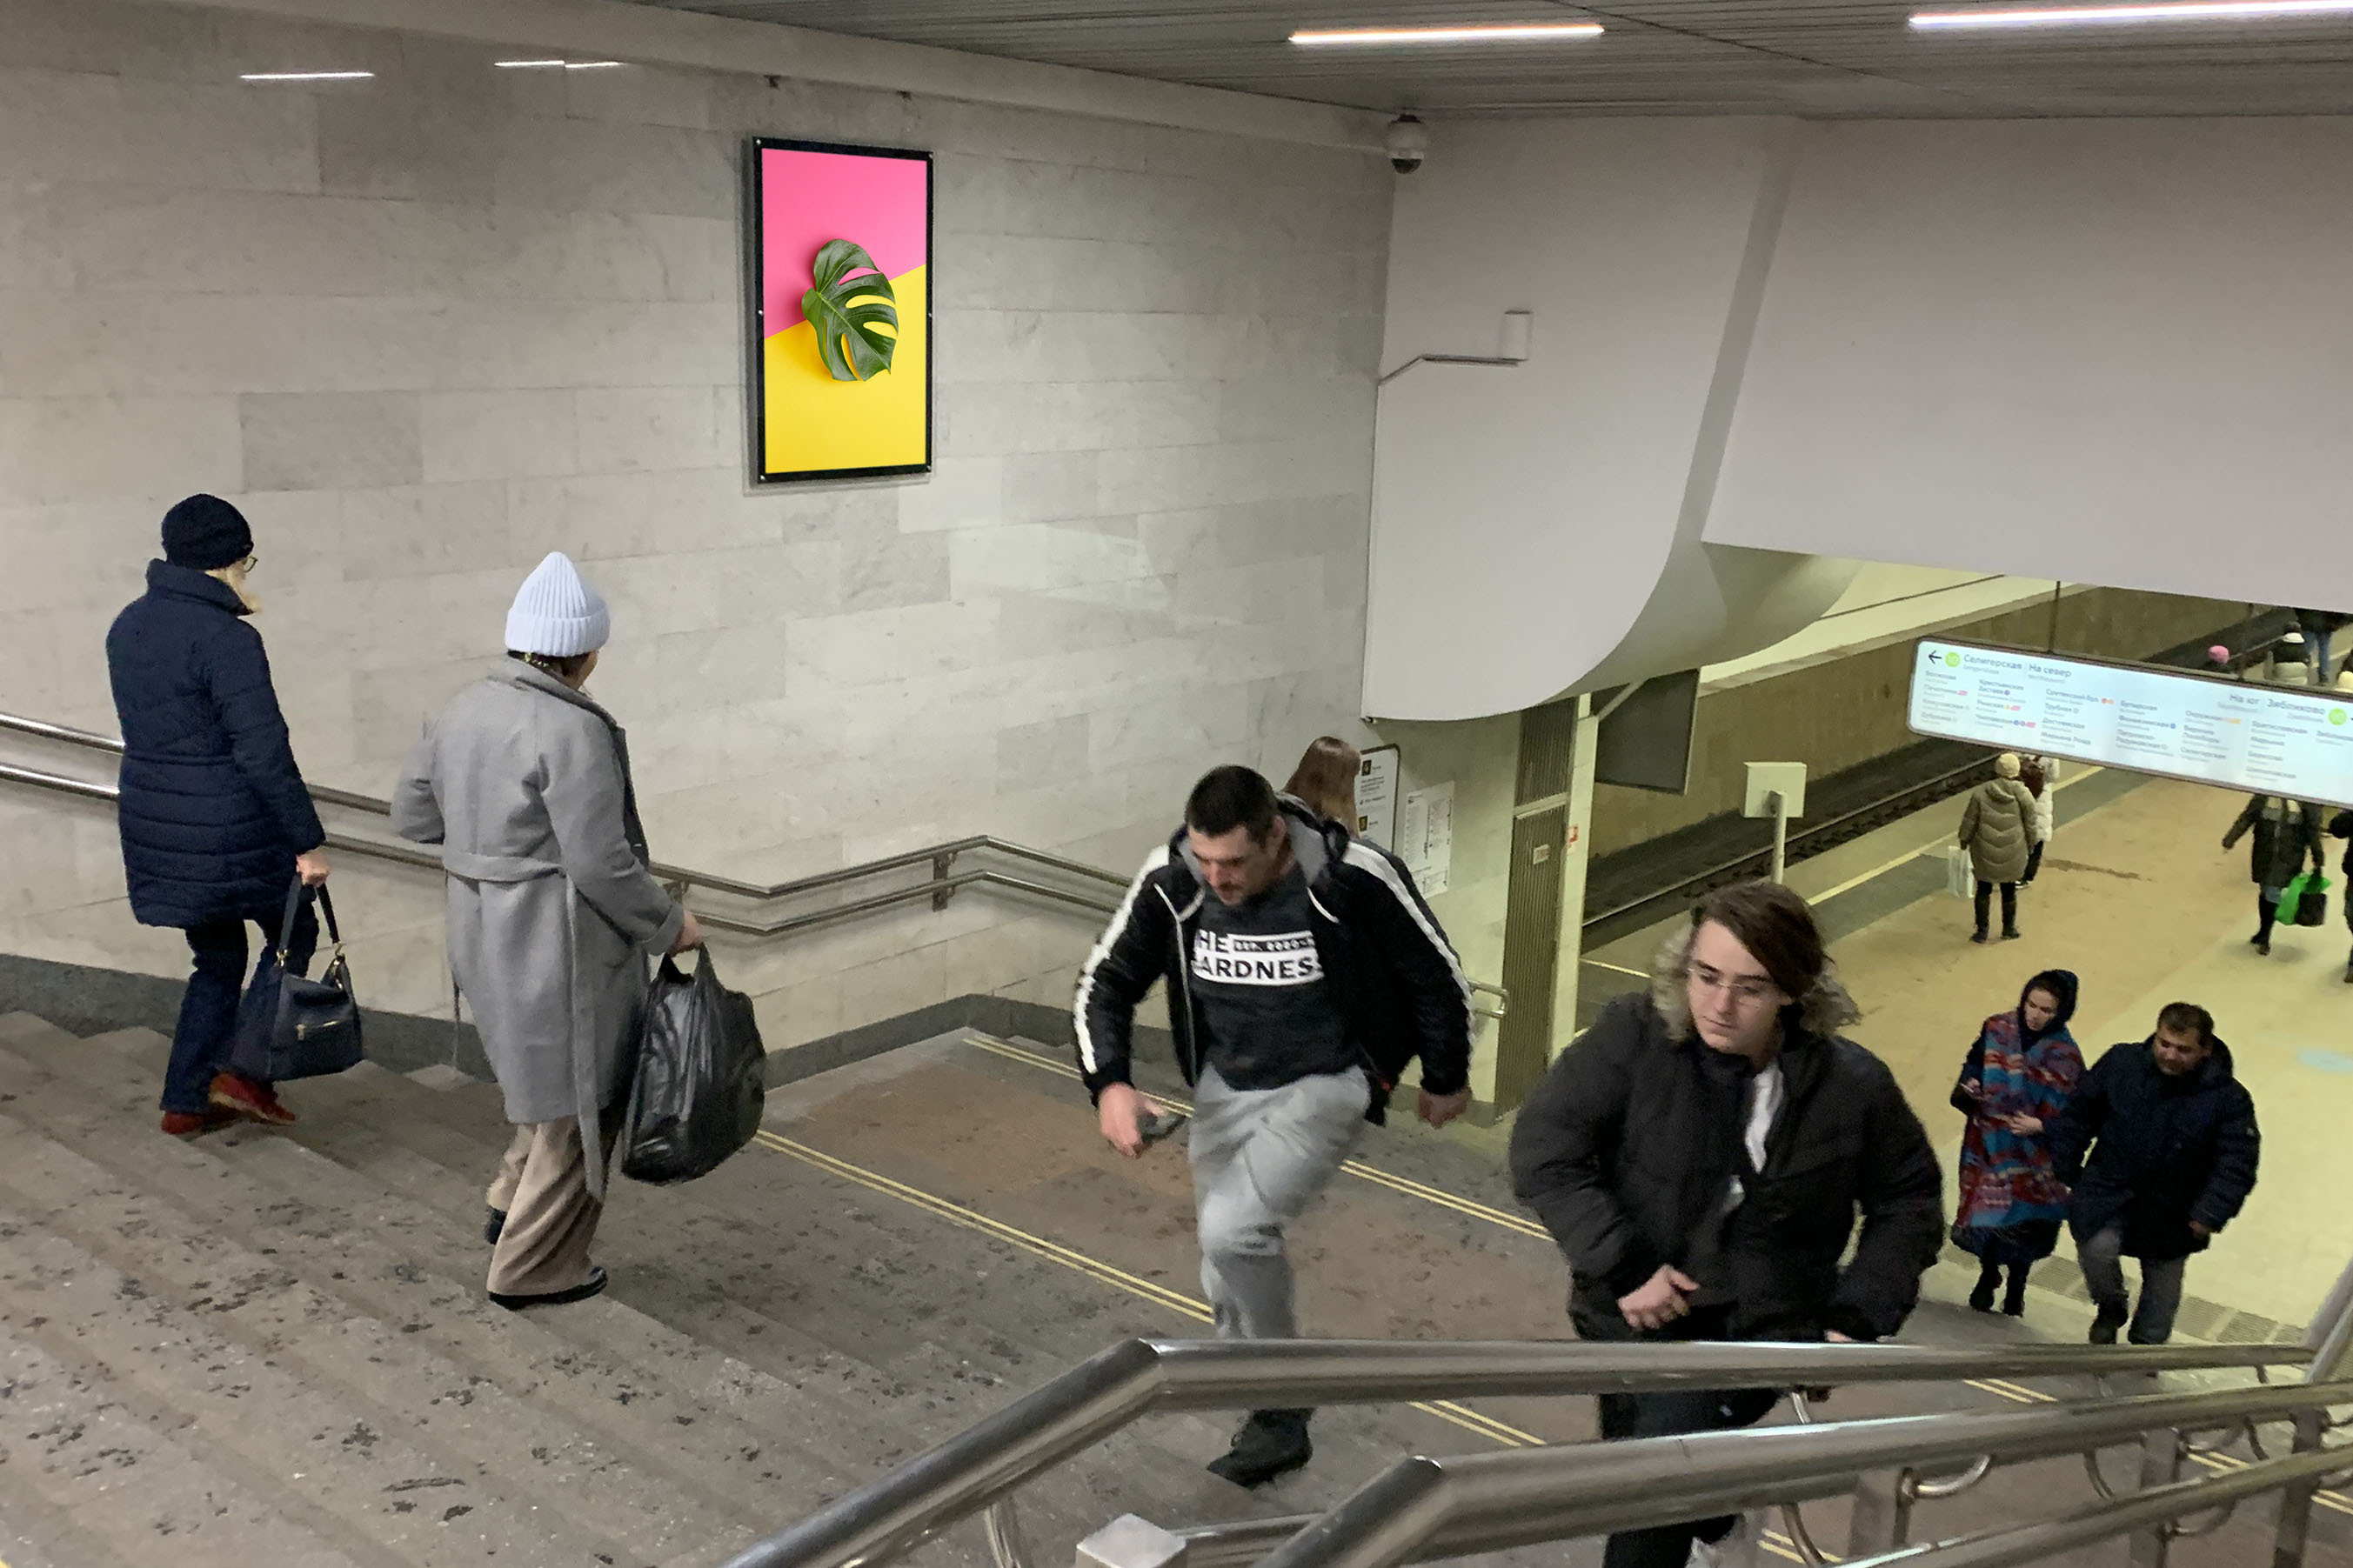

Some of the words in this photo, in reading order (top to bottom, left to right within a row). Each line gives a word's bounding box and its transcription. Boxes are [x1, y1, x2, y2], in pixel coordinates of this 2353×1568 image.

[1963, 654, 2022, 670] Селигерская
[2029, 663, 2042, 672] На
[2043, 666, 2072, 677] север
